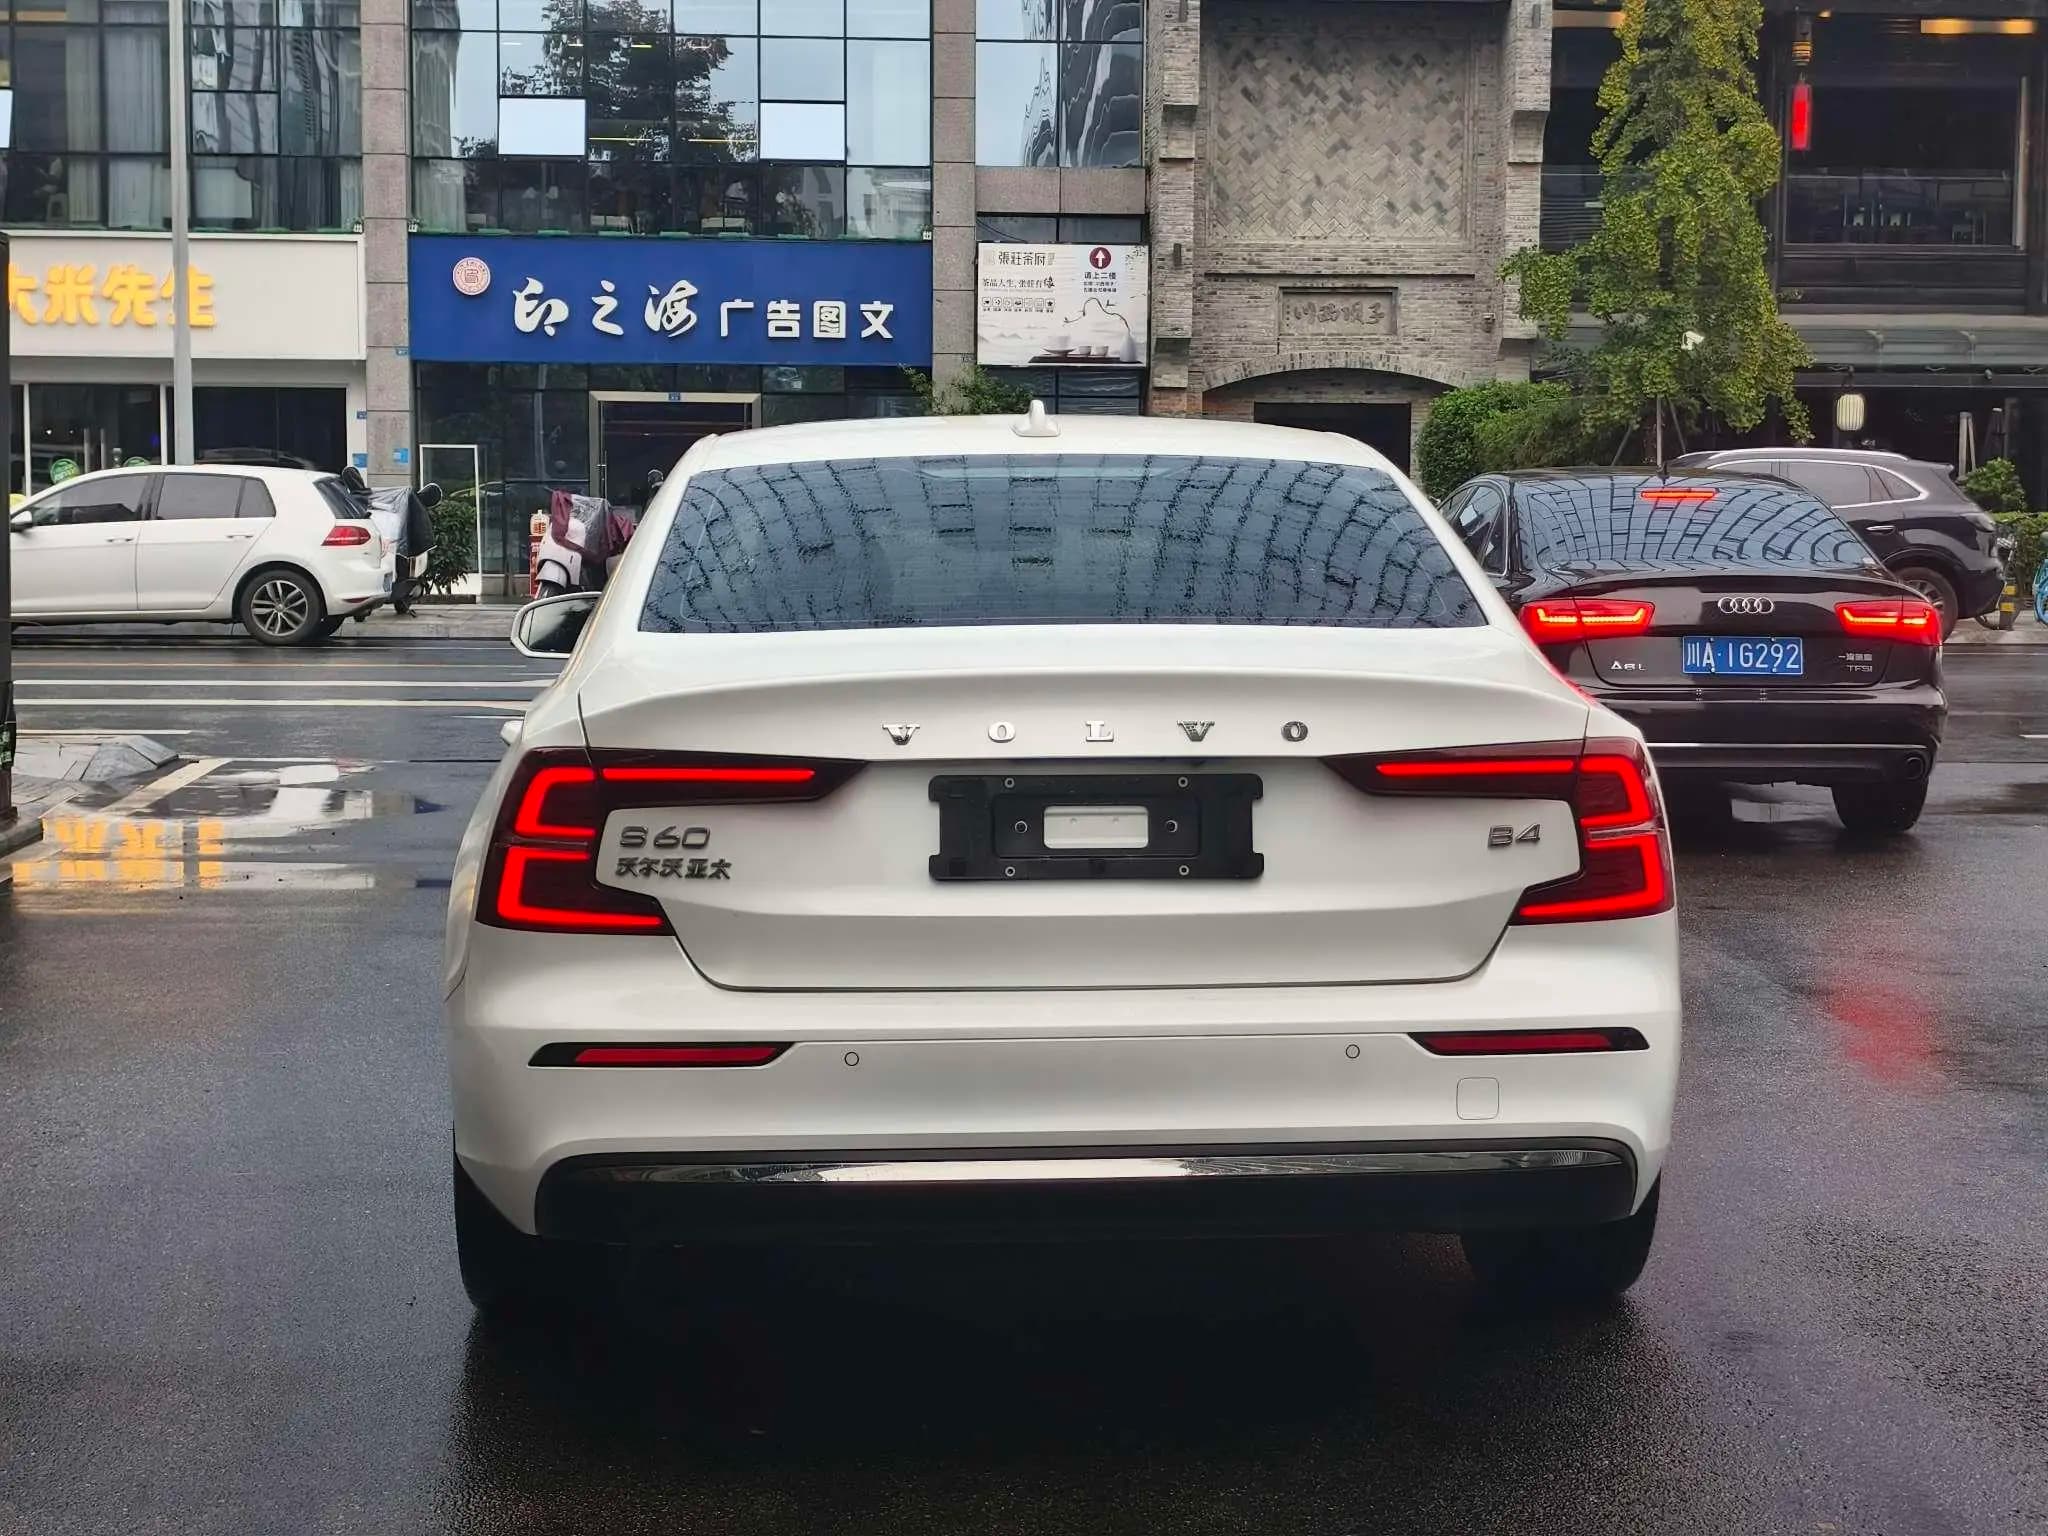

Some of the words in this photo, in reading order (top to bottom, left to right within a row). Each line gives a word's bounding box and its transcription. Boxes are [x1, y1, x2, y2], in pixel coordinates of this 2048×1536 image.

[720, 298, 894, 339] 广告图文
[1846, 664, 1873, 673] TFSI
[882, 720, 1309, 745] VOLVO
[620, 825, 711, 849] S60
[1487, 823, 1541, 848] B4
[615, 856, 732, 880] 沃尔沃亚太
